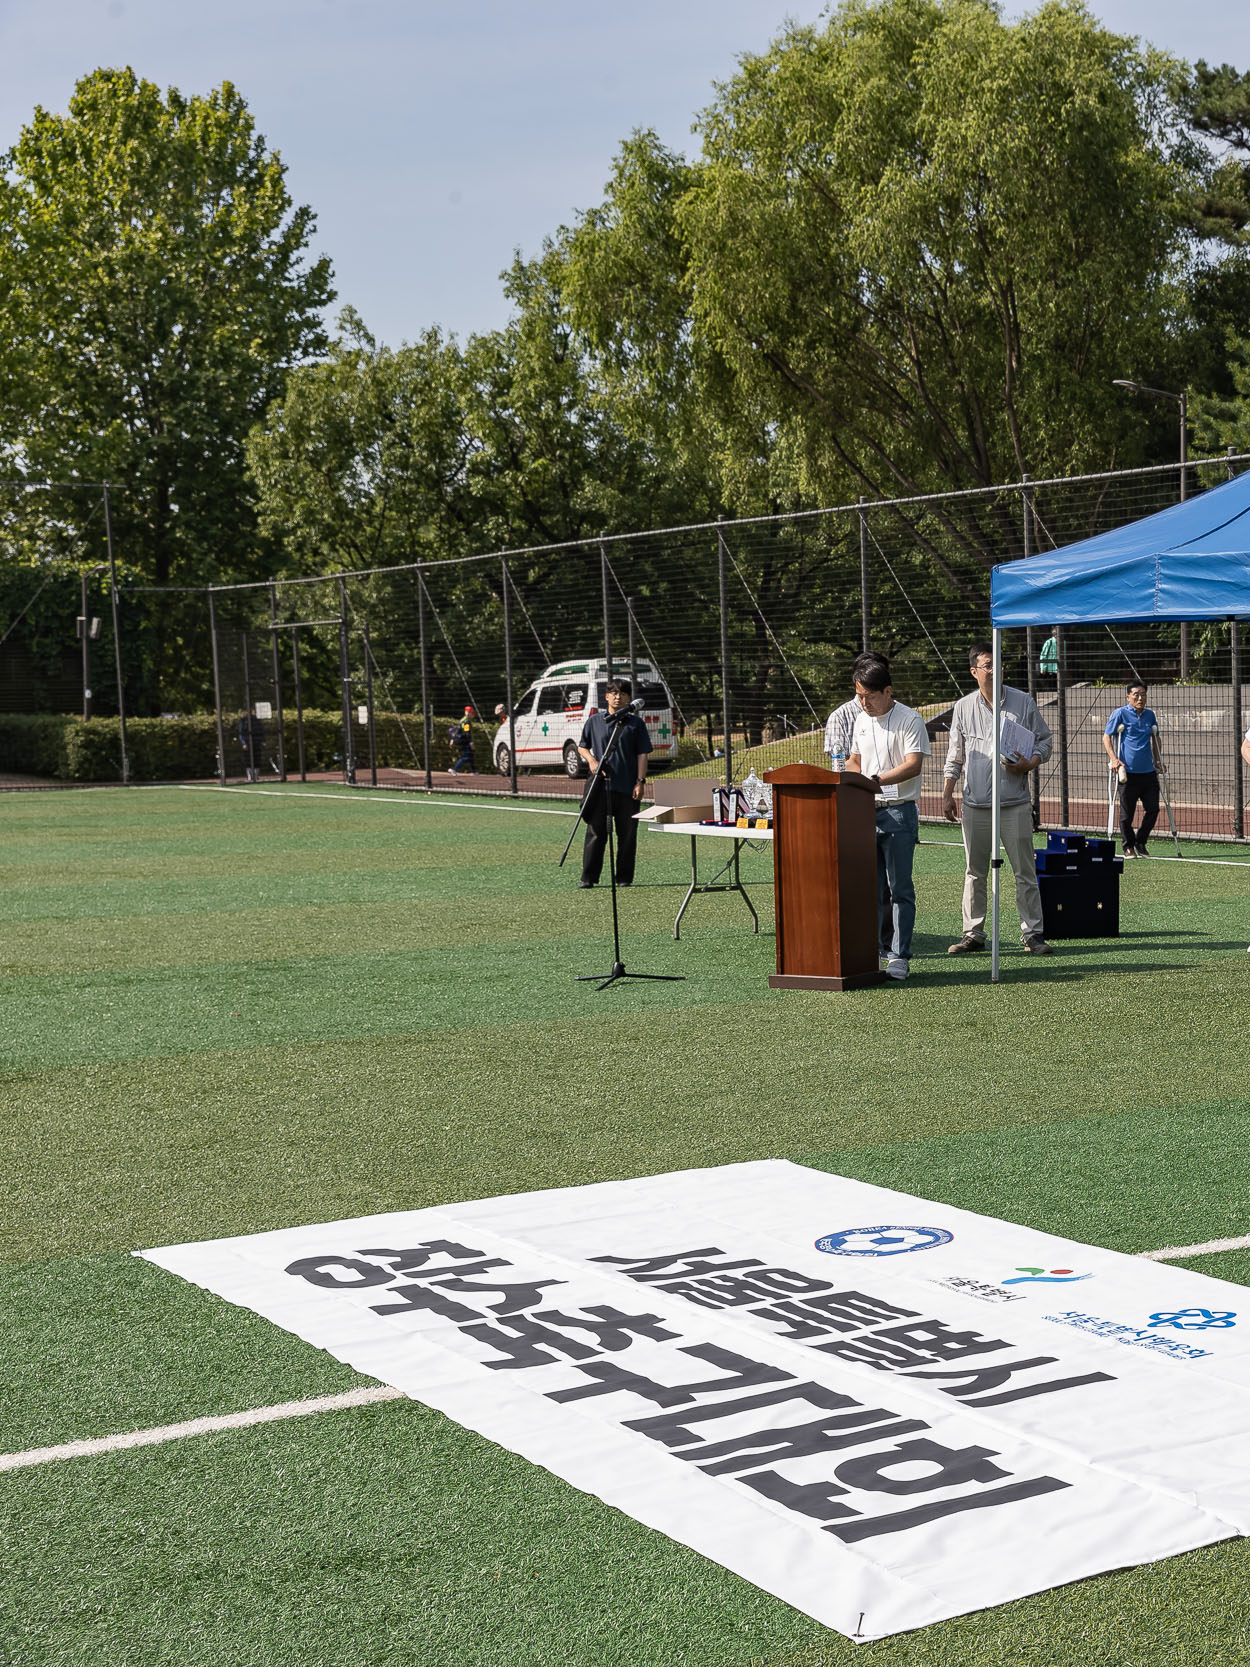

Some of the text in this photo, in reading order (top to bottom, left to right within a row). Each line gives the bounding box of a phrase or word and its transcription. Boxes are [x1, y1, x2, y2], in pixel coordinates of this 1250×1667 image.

[284, 1240, 1073, 1543] 장수축구대회
[586, 1247, 1119, 1408] 서울특별시
[1058, 1311, 1215, 1359] 서울특별시체육회
